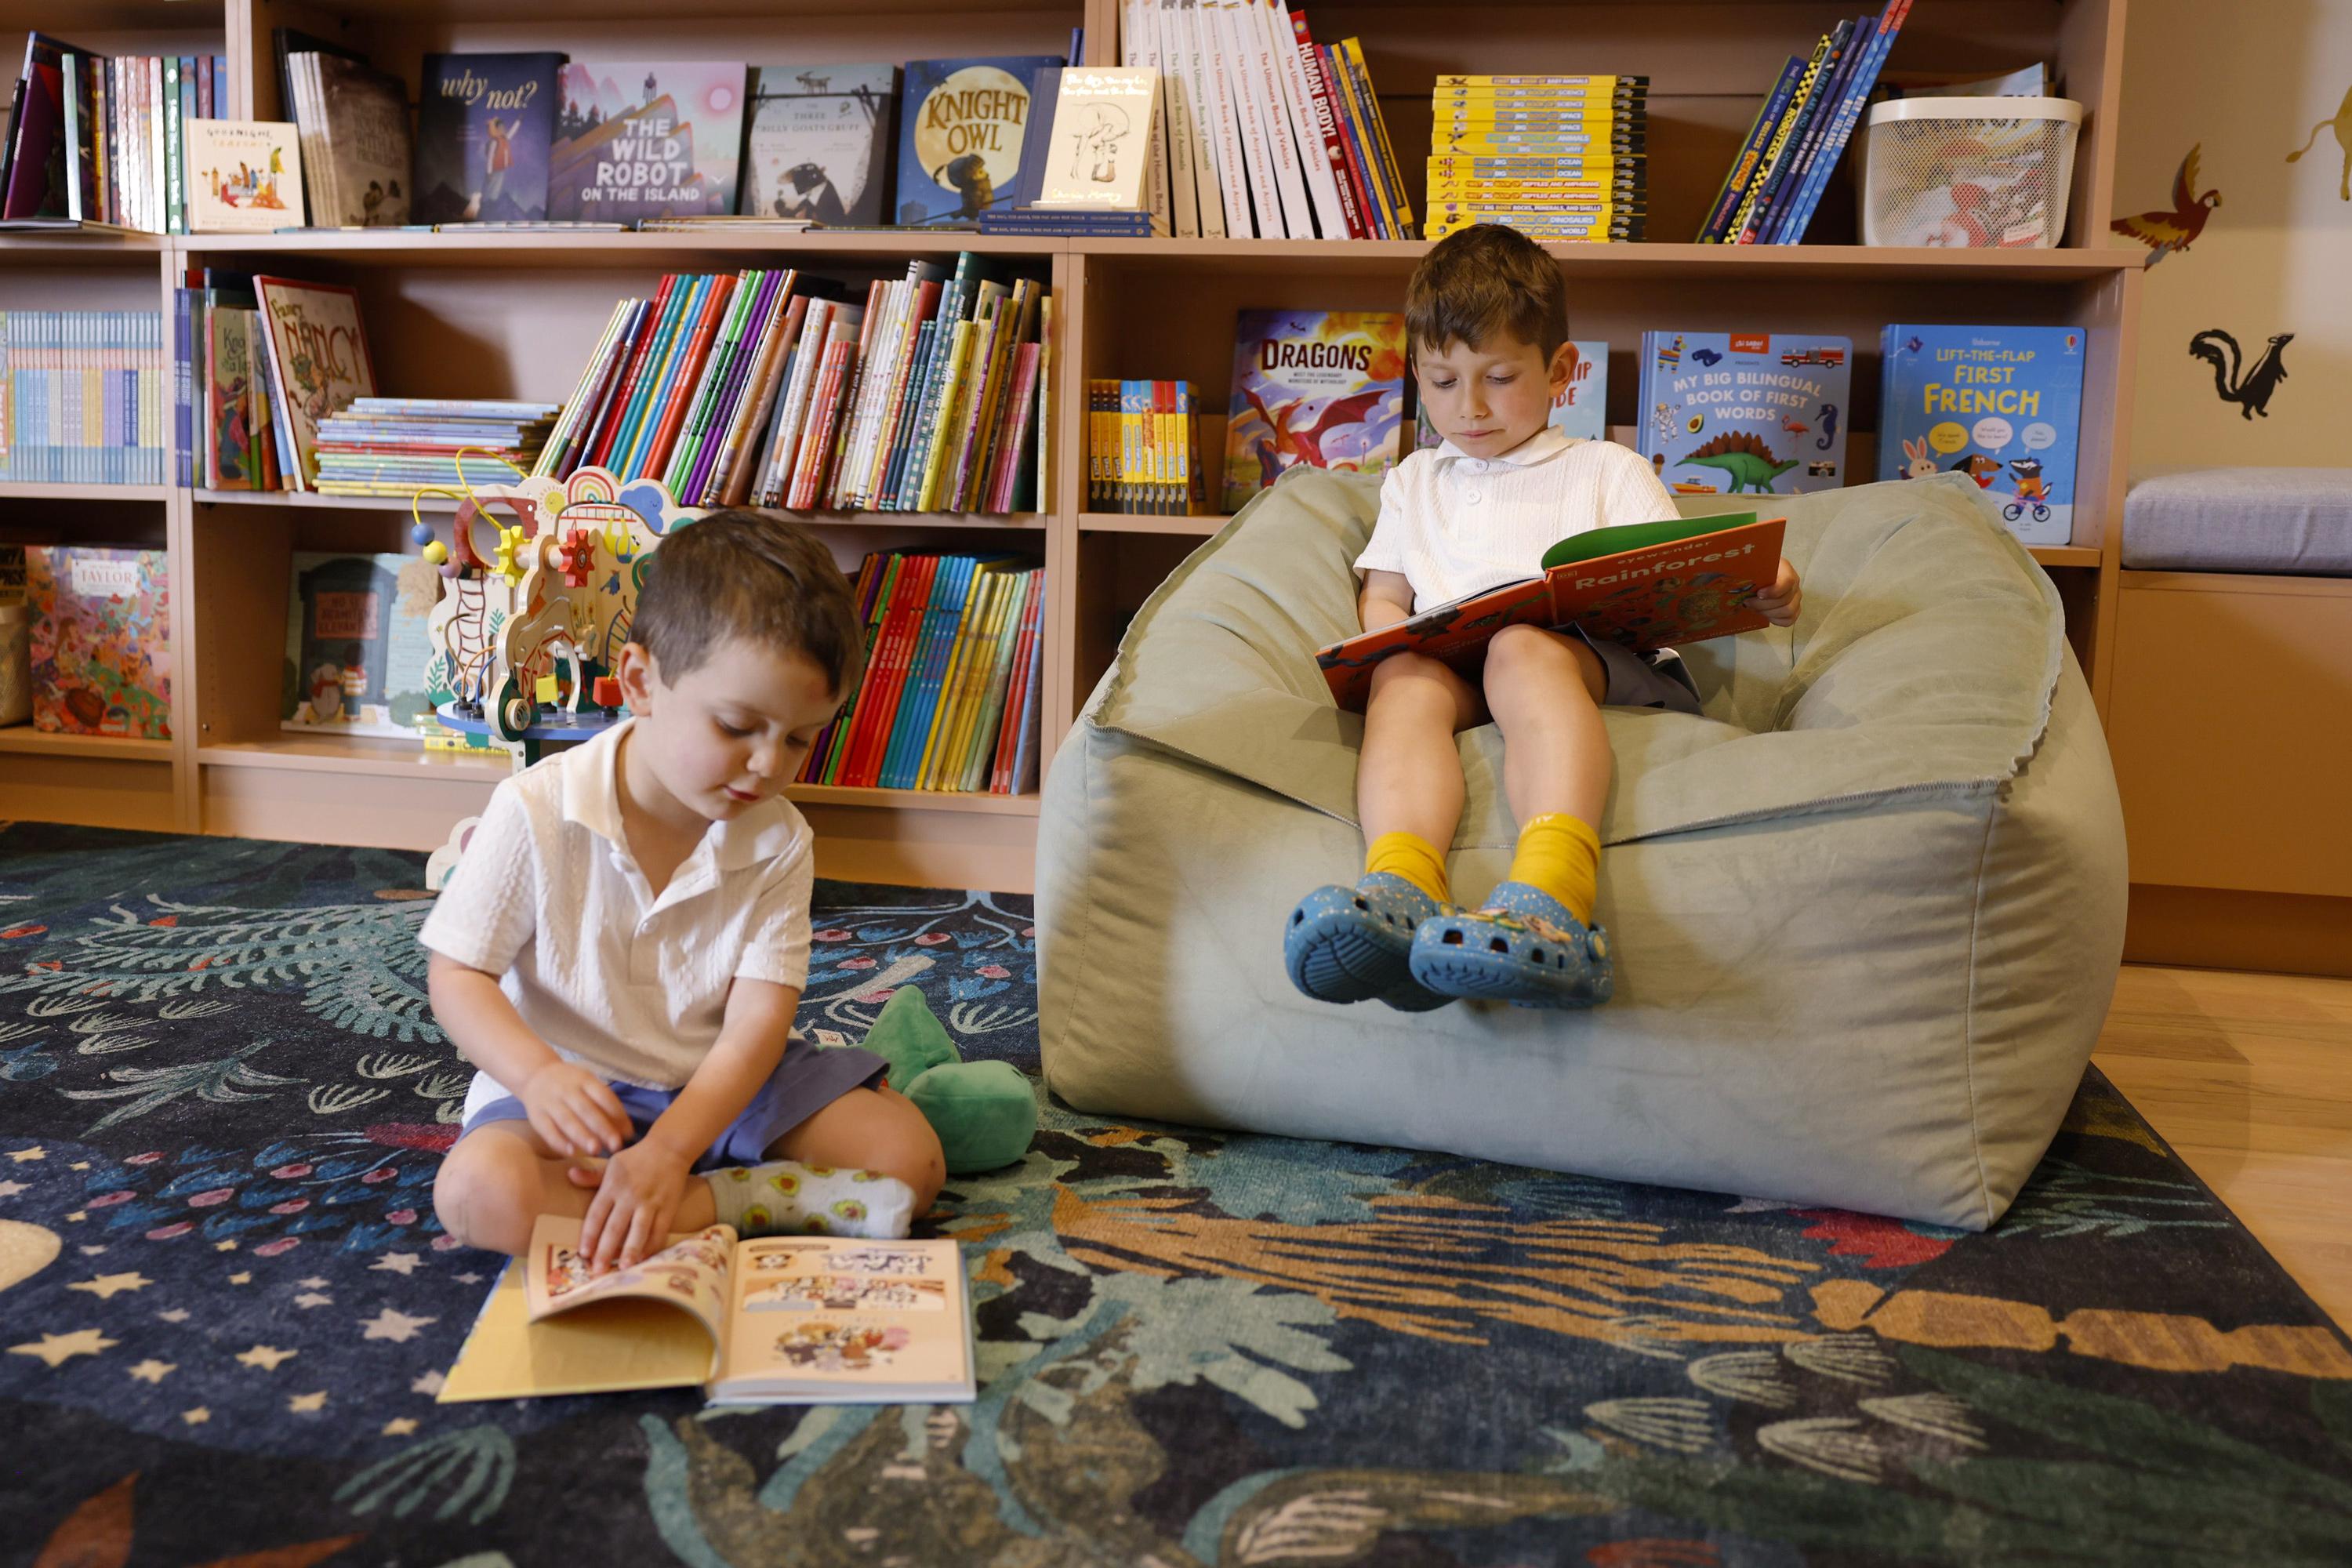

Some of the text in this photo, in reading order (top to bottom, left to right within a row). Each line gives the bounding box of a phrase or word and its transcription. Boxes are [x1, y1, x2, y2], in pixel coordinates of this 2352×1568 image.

[1193, 69, 1202, 103] Ultimate
[1780, 76, 1795, 95] BIG
[1788, 64, 1799, 78] THE
[441, 69, 538, 110] why not?
[1297, 41, 1337, 138] HUMAN BODY!
[926, 89, 1027, 129] KNIGHT
[1264, 68, 1275, 103] Ultimate
[1272, 105, 1280, 125] Book
[1279, 139, 1290, 169] Vehicles
[1290, 71, 1302, 105] Ultimate
[1300, 107, 1310, 127] Book
[1308, 139, 1320, 172] Vehicles
[1798, 111, 1810, 128] NO
[624, 119, 670, 136] THE
[947, 123, 1004, 154] OWL
[1764, 106, 1796, 162] ROBOTICS
[612, 139, 681, 161] WILD
[1216, 69, 1225, 102] Ultimate
[1225, 136, 1234, 172] Airplanes
[1232, 191, 1241, 221] Airports
[1240, 70, 1250, 103] Ultimate
[1254, 136, 1263, 172] Airplanes
[1263, 191, 1272, 221] Airports
[597, 162, 688, 186] ROBOT
[1766, 150, 1793, 195] QUESTIONS
[1788, 148, 1806, 175] BALANCE
[582, 188, 700, 201] ON THE ISLAND
[283, 320, 363, 384] NANCY
[1261, 339, 1372, 372] DRAGONS
[1936, 349, 2036, 362] LIFT-THE-FLAP
[851, 373, 860, 387] NOT
[1674, 372, 1822, 397] MY BIG BILINGUAL
[1955, 365, 2016, 384] FIRST
[971, 373, 986, 427] Bear Feels Sad
[1686, 390, 1809, 409] BOOK OF FIRST
[1715, 407, 1777, 422] WORDS
[1924, 383, 2042, 417] FRENCH
[81, 570, 133, 583] TAYLOR
[1575, 543, 1755, 590] Rainforest
